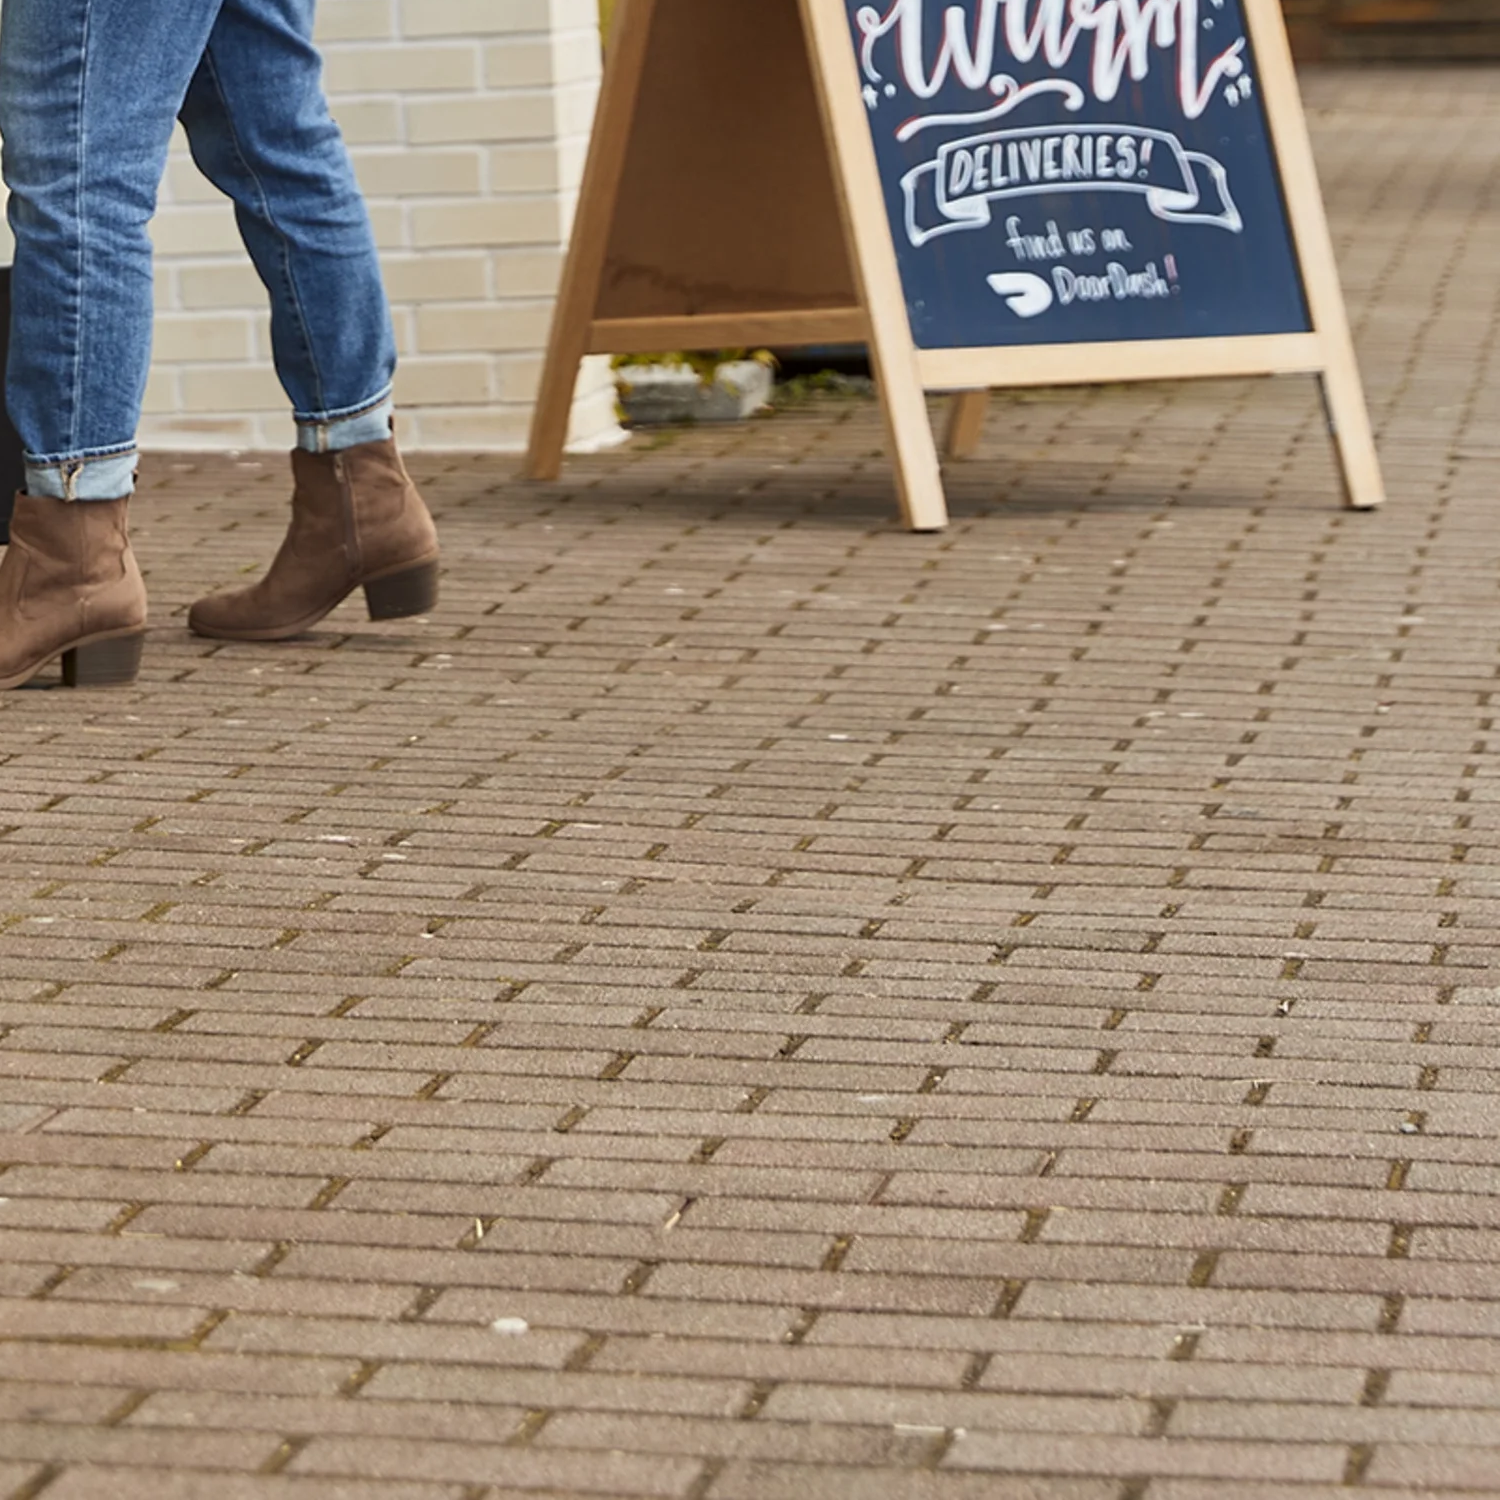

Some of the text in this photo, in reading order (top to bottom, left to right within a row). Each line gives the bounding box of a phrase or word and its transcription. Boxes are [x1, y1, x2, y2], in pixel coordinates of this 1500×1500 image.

[949, 133, 1152, 196] DELIVERIES!
[1005, 215, 1134, 260] find us on
[1051, 253, 1181, 306] DoorDash!
